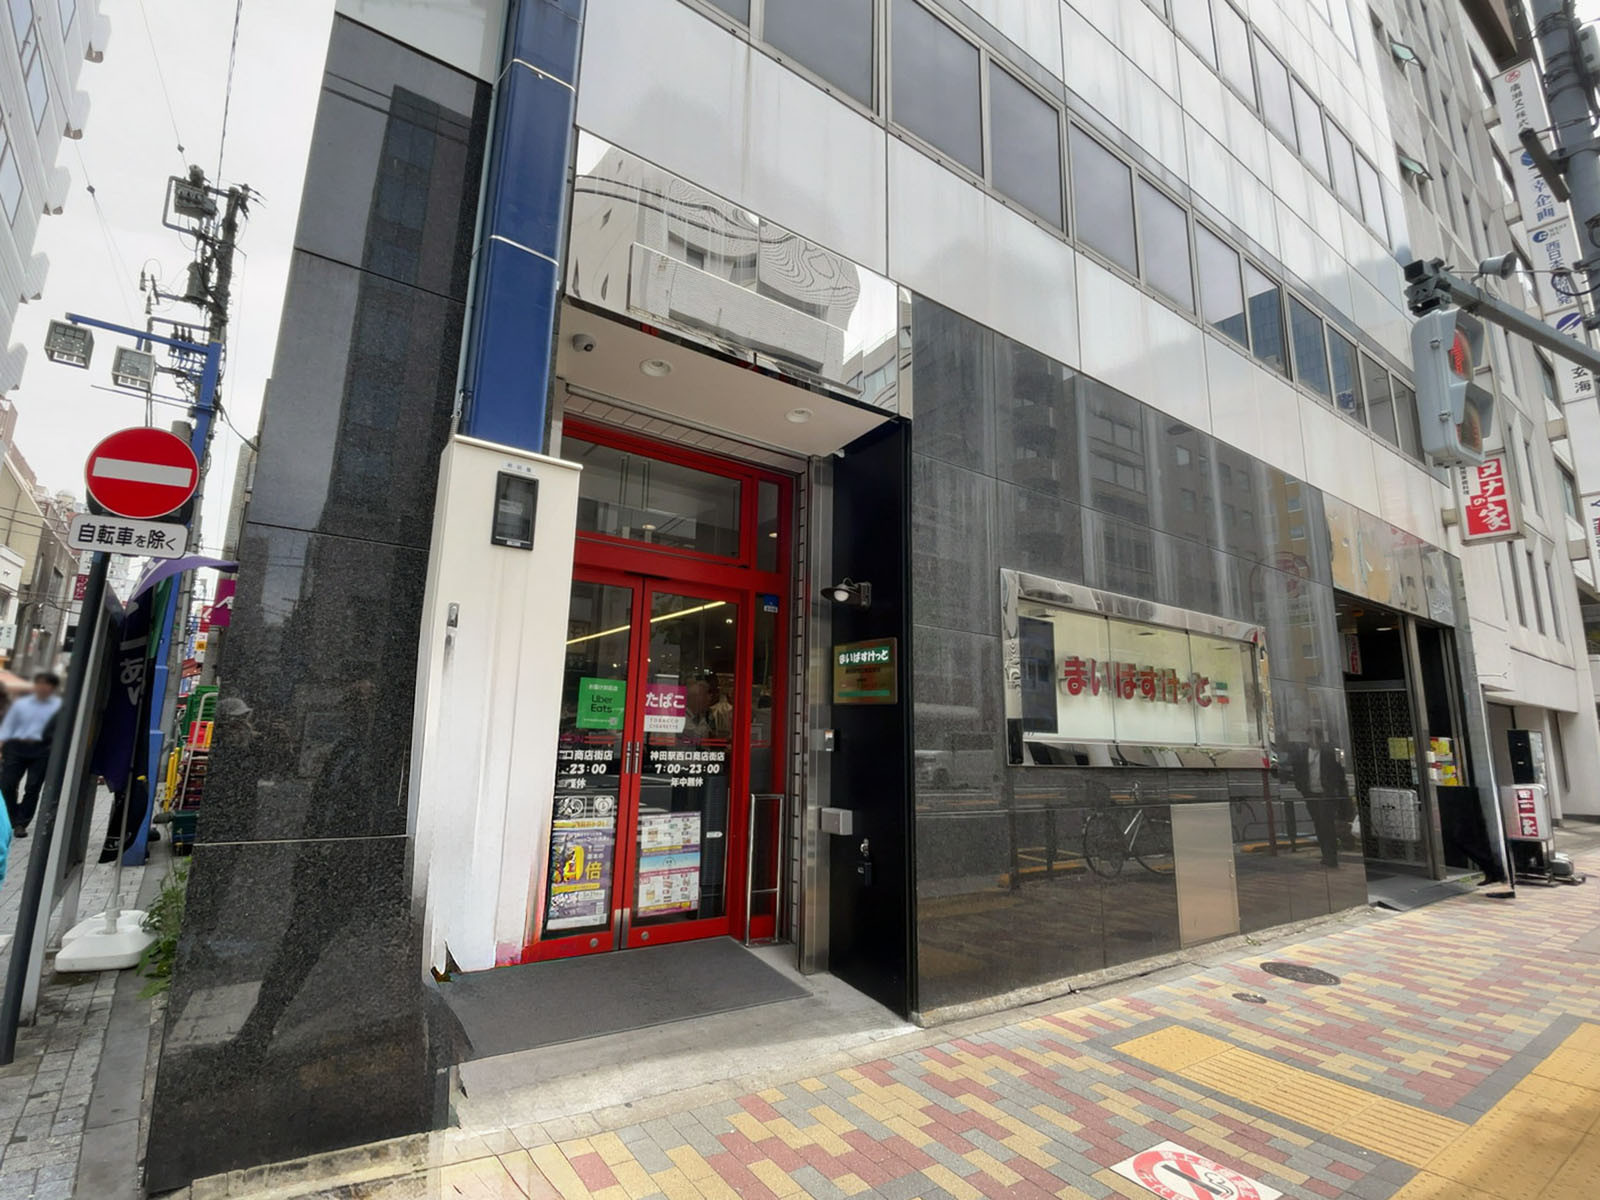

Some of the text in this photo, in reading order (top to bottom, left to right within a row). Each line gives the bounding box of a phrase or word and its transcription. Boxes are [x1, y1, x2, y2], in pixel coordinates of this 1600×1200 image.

[78, 523, 177, 551] 自転車を除く
[839, 649, 889, 664] まいばすけっと
[592, 694, 613, 704] Uber
[645, 692, 685, 708] たばこ
[591, 703, 613, 713] Eats
[650, 750, 725, 761] 神田駅西口商店街店
[671, 777, 703, 787] 年中無休
